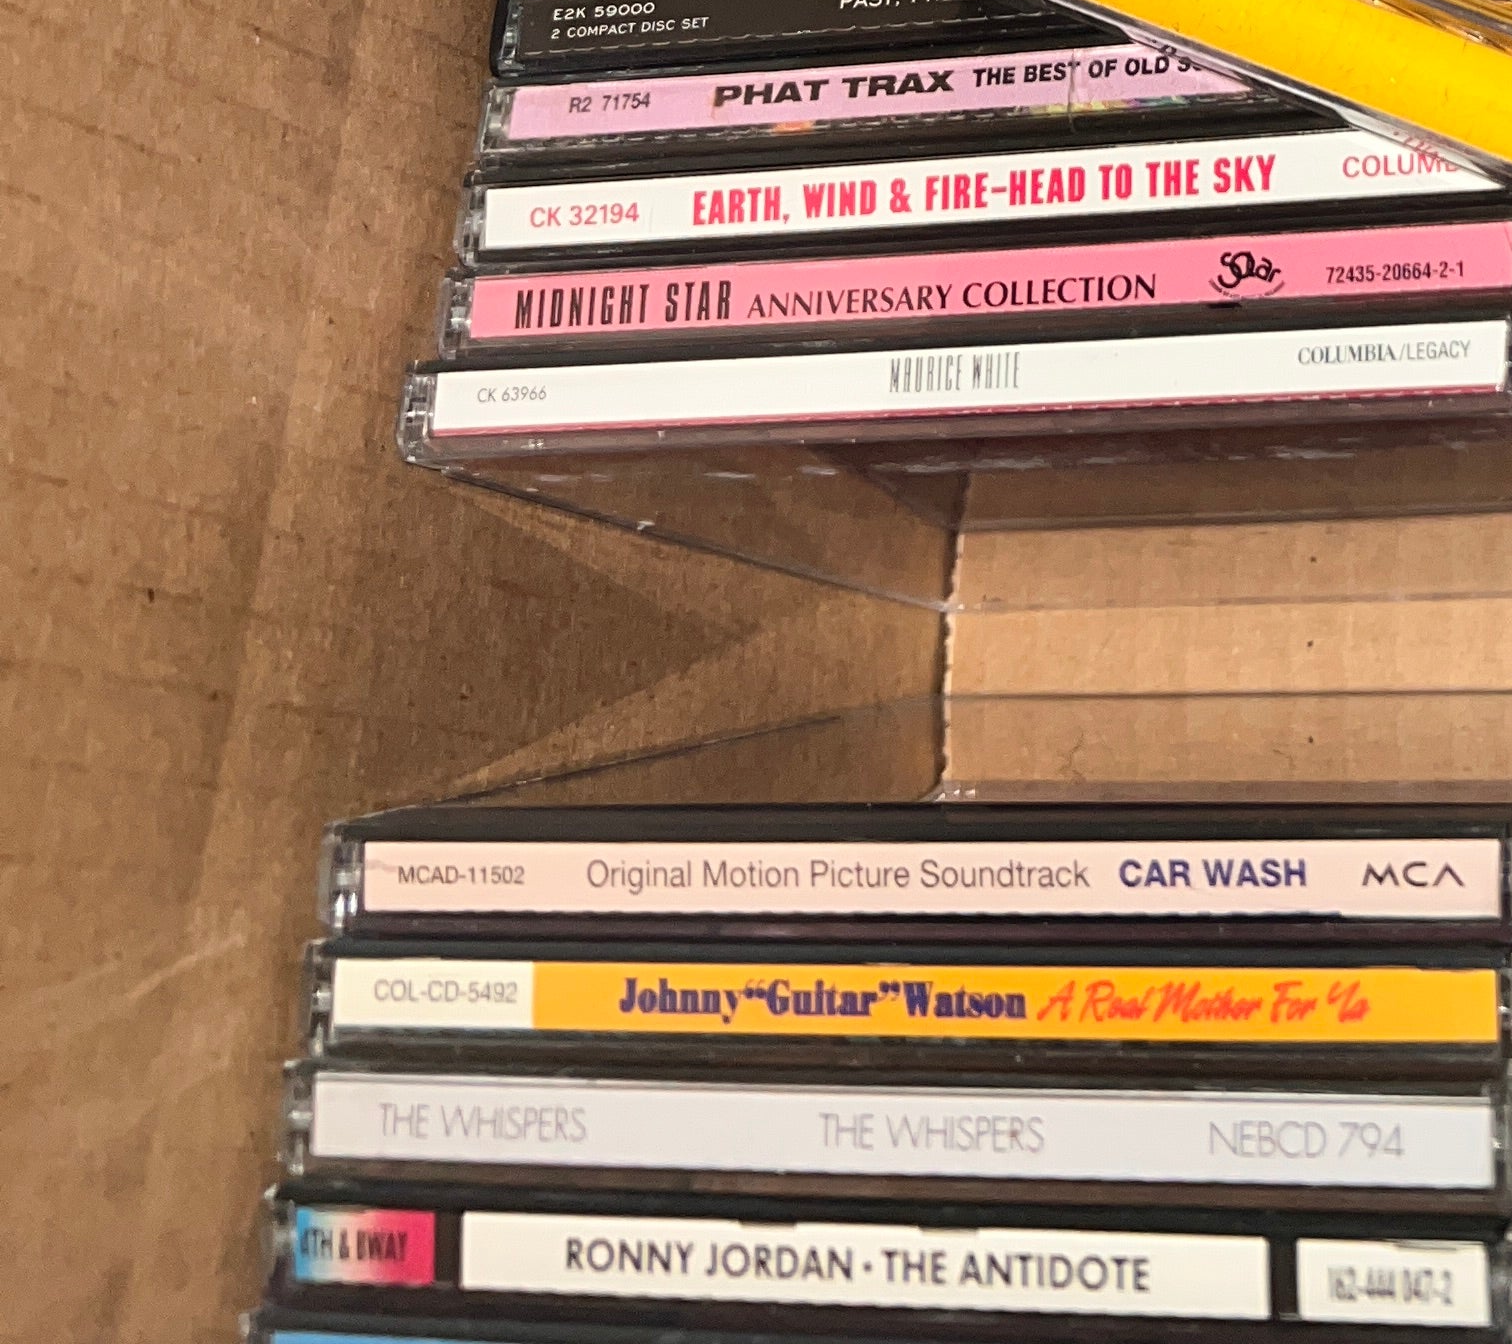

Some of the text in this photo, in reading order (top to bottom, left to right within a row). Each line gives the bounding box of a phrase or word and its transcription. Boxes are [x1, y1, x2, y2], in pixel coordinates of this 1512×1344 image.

[552, 0, 656, 21] E2K 59000
[568, 95, 593, 114] R2
[600, 91, 651, 112] 71754
[712, 78, 832, 108] PHAT
[842, 69, 955, 99] TRAX
[972, 66, 1017, 88] THE
[1023, 61, 1082, 85] BEST
[1089, 58, 1118, 80] OF
[1124, 54, 1171, 77] OLD
[529, 154, 1278, 229] CK 32194 EARTH, WIND & TO THE SKY
[514, 260, 1465, 330] MIDNIGHT STAR ANNIVERSARY COLLECTION 72435-20664-2-1
[476, 350, 1023, 404] CK 63966 MAURICE WHITE
[397, 858, 1307, 894] MCAD-11502 Original Motion Picture Soundtrack CAR WASH
[373, 979, 1320, 1023] COL-CD-5492 A Mother For
[379, 1101, 1406, 1160] THE WHISPERS THE WHISPERS NEBCD 794
[564, 1238, 1151, 1293] RONNY JORDAN THE ANTIDOTE
